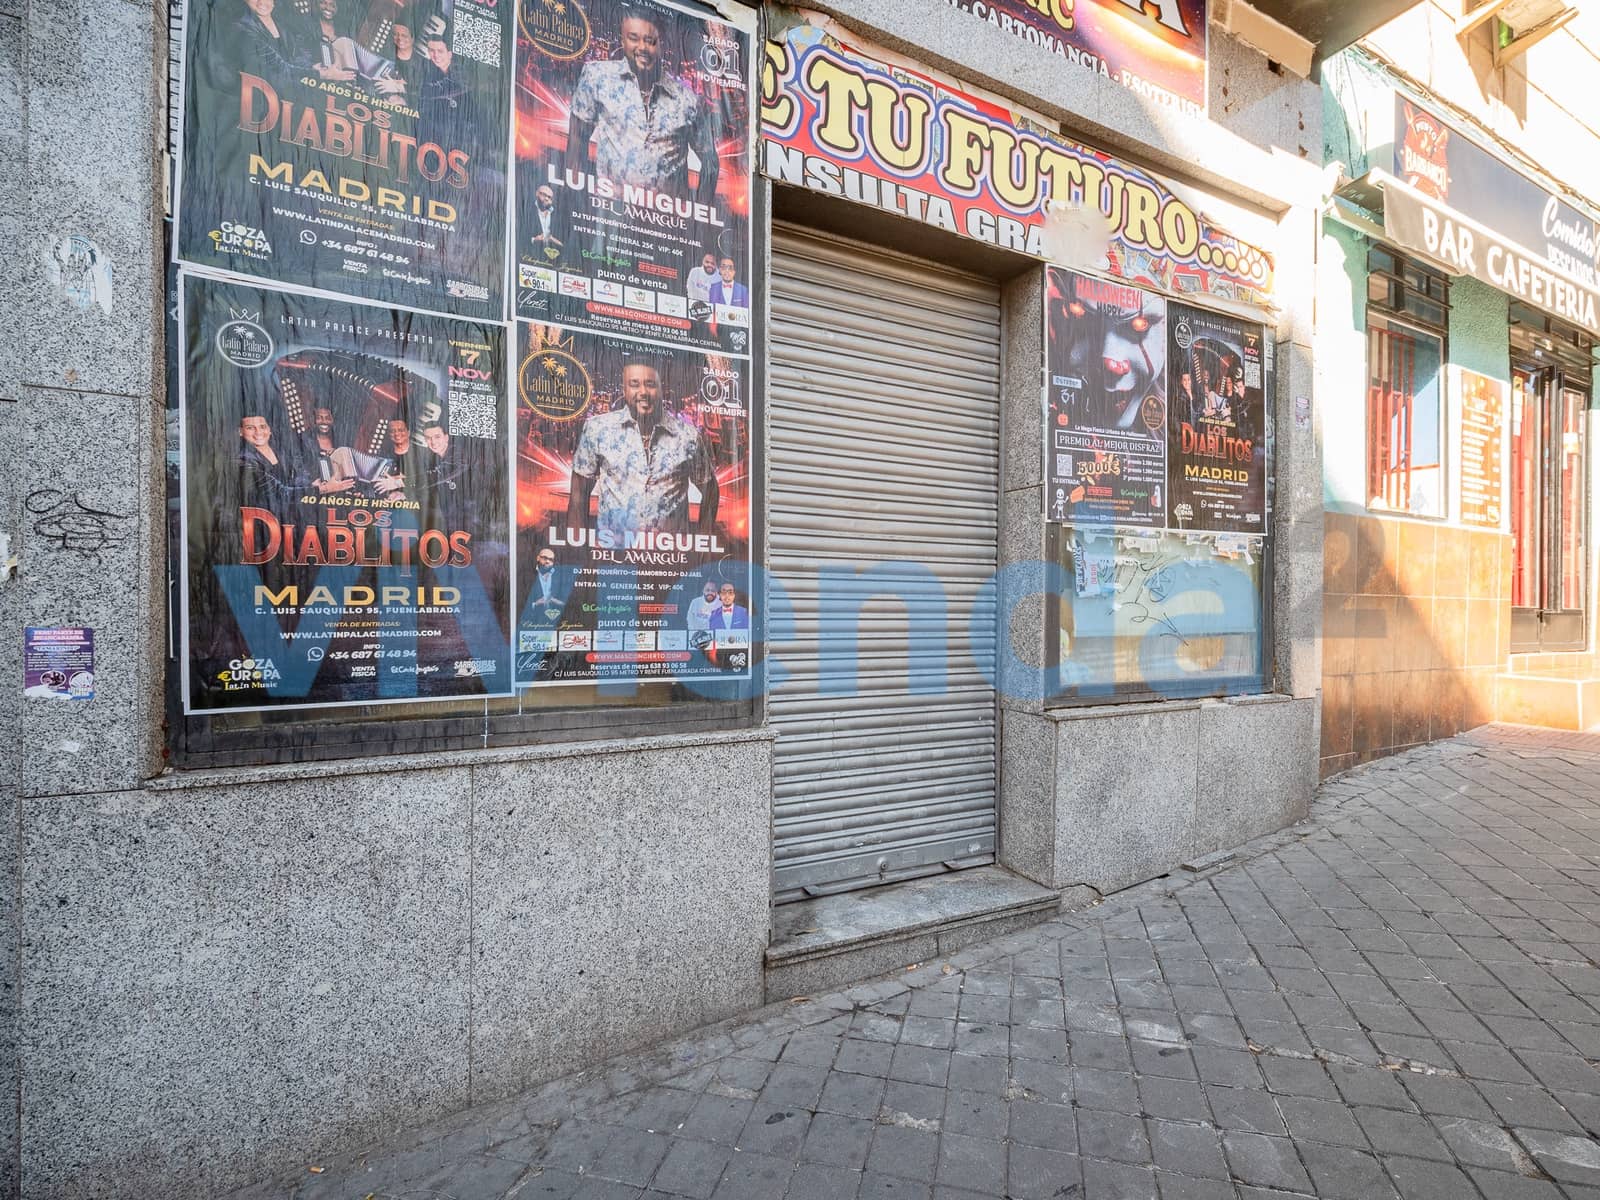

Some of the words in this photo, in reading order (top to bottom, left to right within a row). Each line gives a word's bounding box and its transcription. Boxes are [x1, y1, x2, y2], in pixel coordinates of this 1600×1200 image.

[524, 8, 550, 26] Latin
[552, 15, 584, 40] Palace
[534, 28, 574, 47] MADRID
[972, 4, 1112, 79] CARTOMANCIA
[700, 44, 742, 81] 01
[697, 71, 747, 92] NOVIEMBRE
[300, 76, 316, 88] 40
[318, 80, 352, 99] AÑOS
[354, 90, 369, 104] DE
[370, 96, 420, 118] HISTORIA
[325, 95, 392, 128] LOS
[806, 55, 931, 171] TU
[236, 71, 470, 189] DIABLITOS
[249, 154, 458, 223] MADRID
[547, 164, 614, 198] LUIS
[624, 183, 725, 228] MIGUEL
[760, 138, 958, 236] NSULTA
[249, 176, 261, 186] C.
[264, 179, 291, 192] LUIS
[294, 186, 358, 209] SAUQUILLO
[380, 208, 456, 232] FUENLABRADA
[591, 196, 624, 218] DEL
[624, 204, 688, 230] AMARGUE
[220, 221, 266, 241] GOZA
[272, 206, 436, 250] WWW.LATINPALACEMADRID.COM
[573, 225, 606, 238] ENTRADA
[610, 234, 640, 247] GENERAL
[1422, 207, 1476, 272] BAR
[1487, 246, 1598, 329] CAFETERIA
[597, 268, 626, 282] punto
[628, 274, 640, 285] de
[642, 278, 668, 290] venta
[281, 314, 316, 329] LATIN
[325, 321, 370, 336] PALACE
[377, 329, 434, 345] PRESENTA
[591, 314, 621, 325] Reservas
[222, 336, 241, 350] Latin
[243, 340, 269, 353] Palace
[1248, 338, 1256, 346] 7
[230, 350, 261, 360] MADRID
[460, 349, 480, 365] 7
[448, 365, 492, 381] NOV
[526, 373, 551, 392] Latin
[553, 376, 585, 399] Palace
[701, 374, 742, 408] 01
[536, 395, 575, 407] MADRID
[1061, 389, 1075, 405] 31
[698, 404, 747, 417] NOVIEMBRE
[1208, 424, 1227, 436] LOS
[1060, 435, 1090, 447] PREMIO
[1092, 439, 1103, 448] AL
[1104, 440, 1129, 450] MEJOR
[1130, 442, 1161, 453] DISFRAZ
[1185, 464, 1249, 482] MADRID
[301, 495, 316, 504] 40
[319, 495, 351, 506] AÑOS
[354, 497, 369, 507] DE
[371, 499, 421, 510] HISTORIA
[326, 508, 392, 527] LOS
[240, 506, 472, 577] DIABLITOS
[548, 526, 616, 549] LUIS
[624, 531, 725, 553] MIGUEL
[590, 550, 622, 563] DEL
[624, 550, 688, 565] AMARGUE
[254, 585, 461, 606] MADRID
[299, 607, 363, 615] SAUQUILLO
[598, 620, 625, 629] punto
[280, 630, 442, 640] WWW.LATINPALACEMADRID.COM
[229, 658, 274, 671] GOZA
[329, 651, 349, 660] +34
[351, 650, 372, 659] 687
[373, 650, 385, 658] 61
[402, 650, 417, 658] 94
[252, 681, 278, 689] Music
